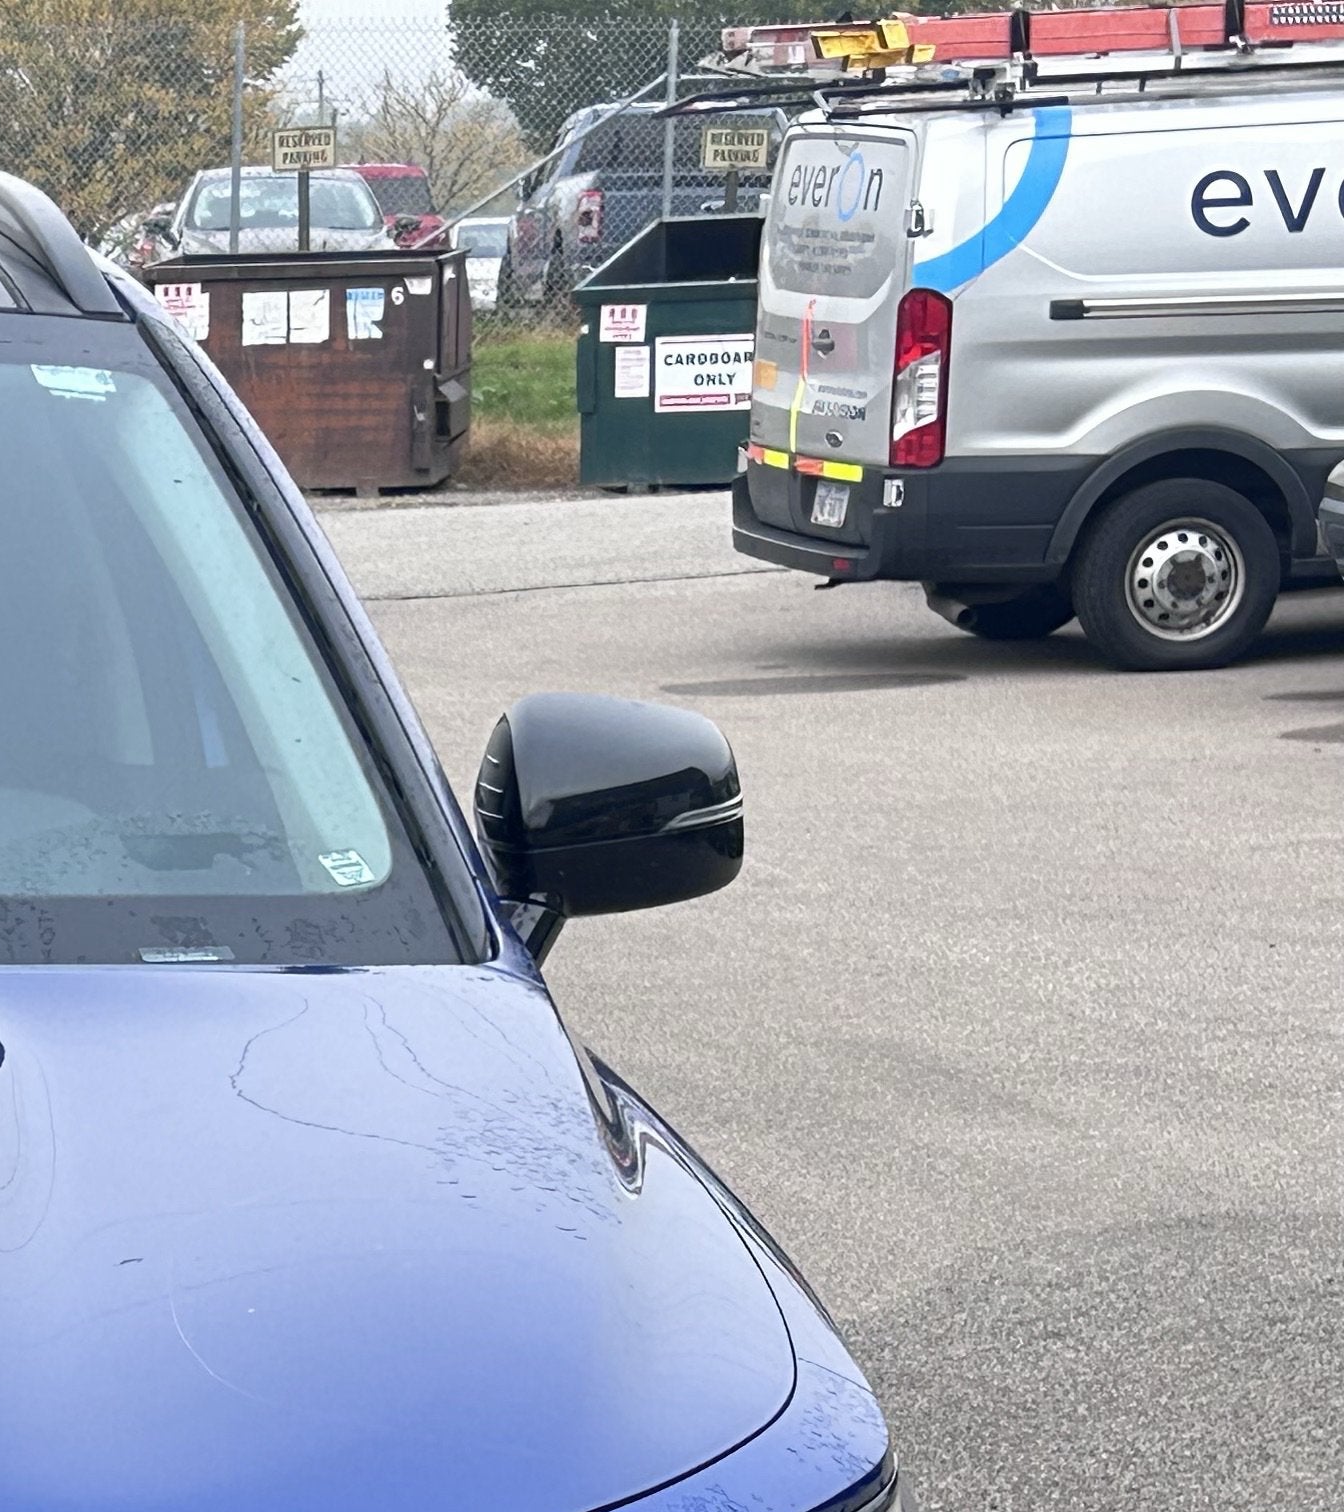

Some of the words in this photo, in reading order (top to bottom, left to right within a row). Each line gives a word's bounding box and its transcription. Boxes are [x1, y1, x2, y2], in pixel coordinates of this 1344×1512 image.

[278, 132, 331, 148] RESERVED
[711, 132, 764, 146] RESERVED
[1191, 167, 1344, 237] ev
[390, 286, 405, 305] 6
[664, 351, 753, 366] CARDBOAR
[694, 372, 736, 386] ONLY
